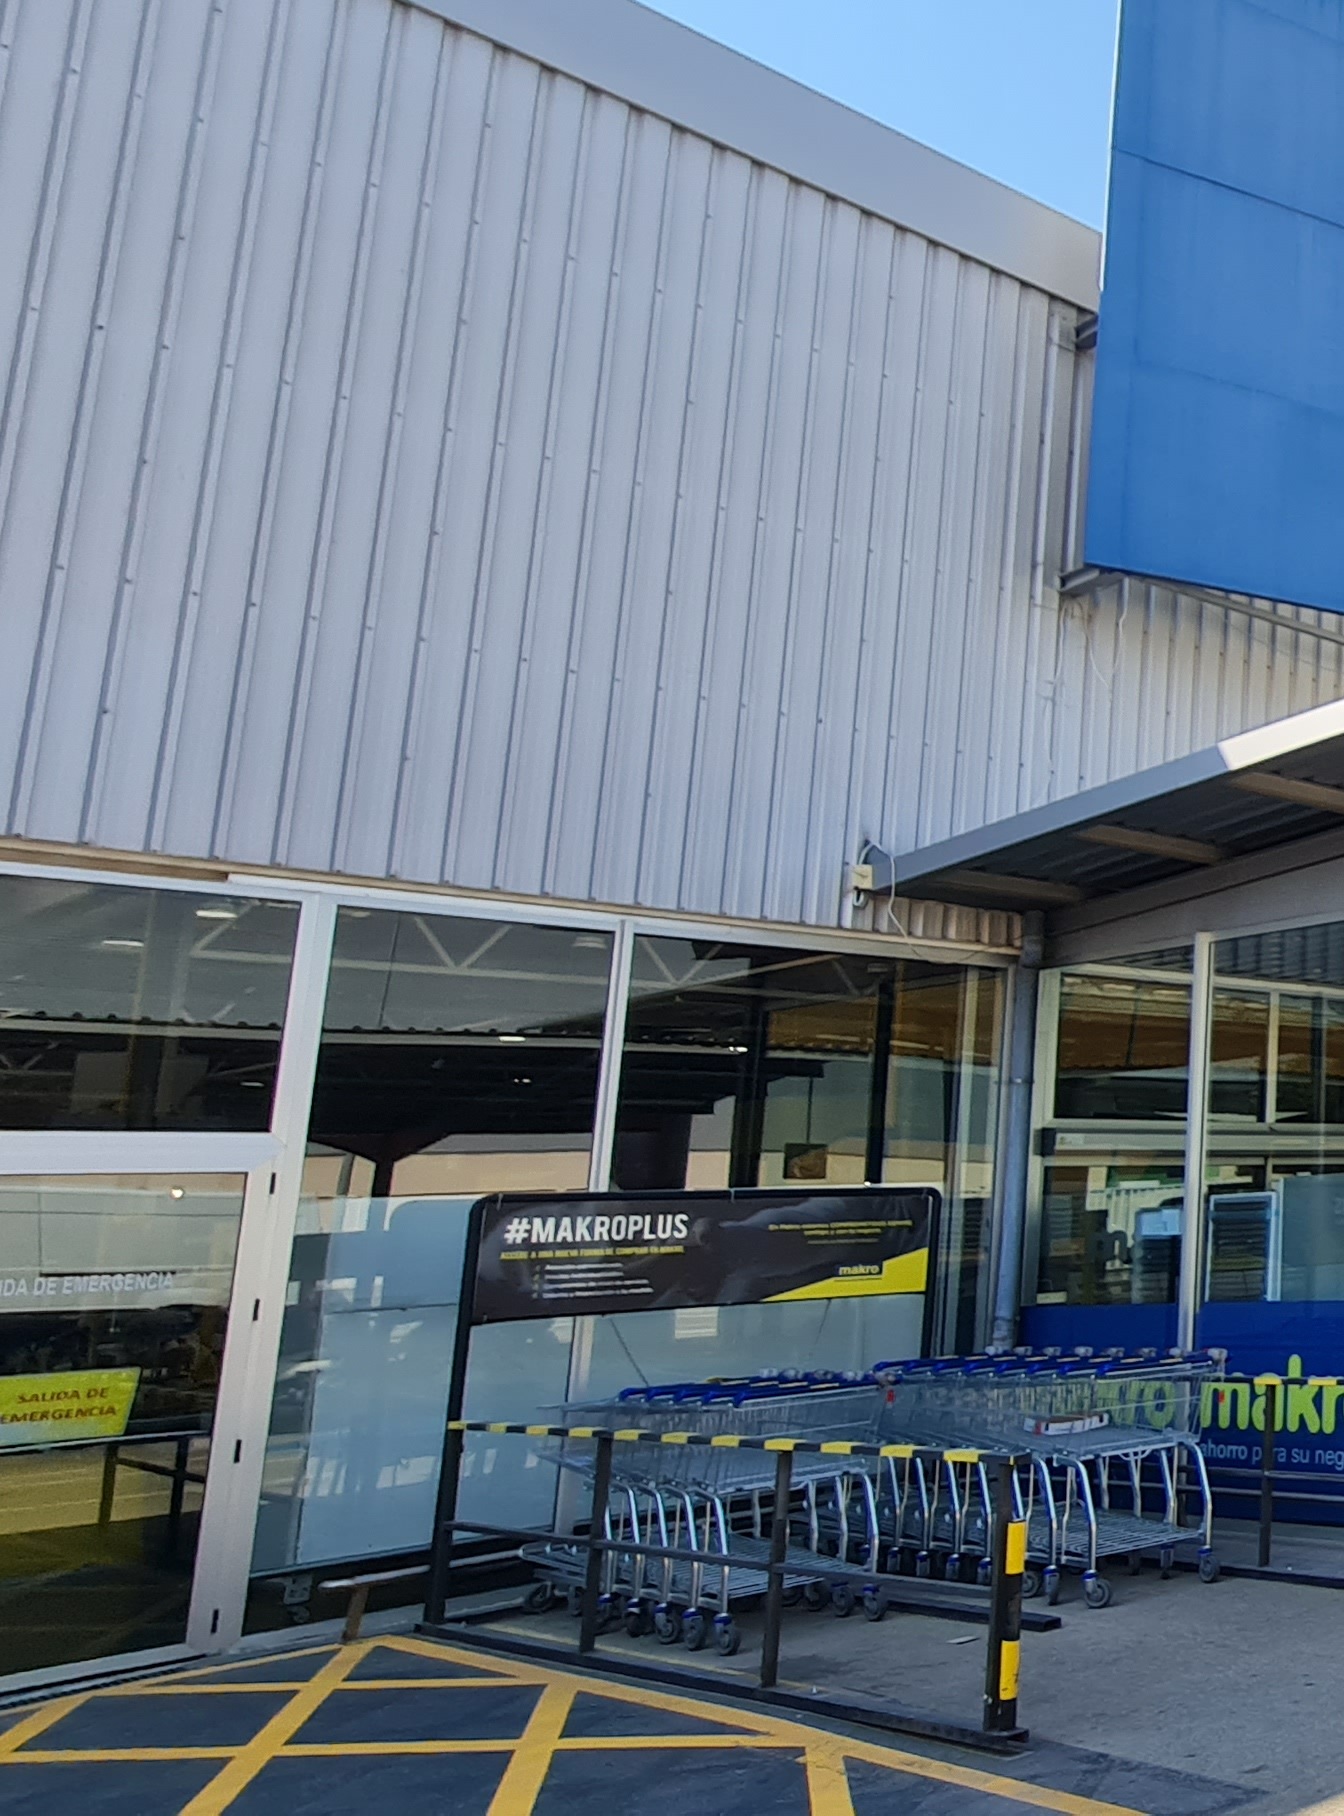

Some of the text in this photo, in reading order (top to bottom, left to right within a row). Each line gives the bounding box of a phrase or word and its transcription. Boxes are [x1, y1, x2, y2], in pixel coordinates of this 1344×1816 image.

[504, 1213, 689, 1245] #MAKROPLUS
[838, 1264, 880, 1275] makro
[33, 1276, 57, 1296] DE
[62, 1271, 173, 1295] EMERGENCIA
[17, 1387, 109, 1404] SALIDA DE
[0, 1405, 116, 1424] EMERGENCIA
[1290, 1447, 1309, 1464] su
